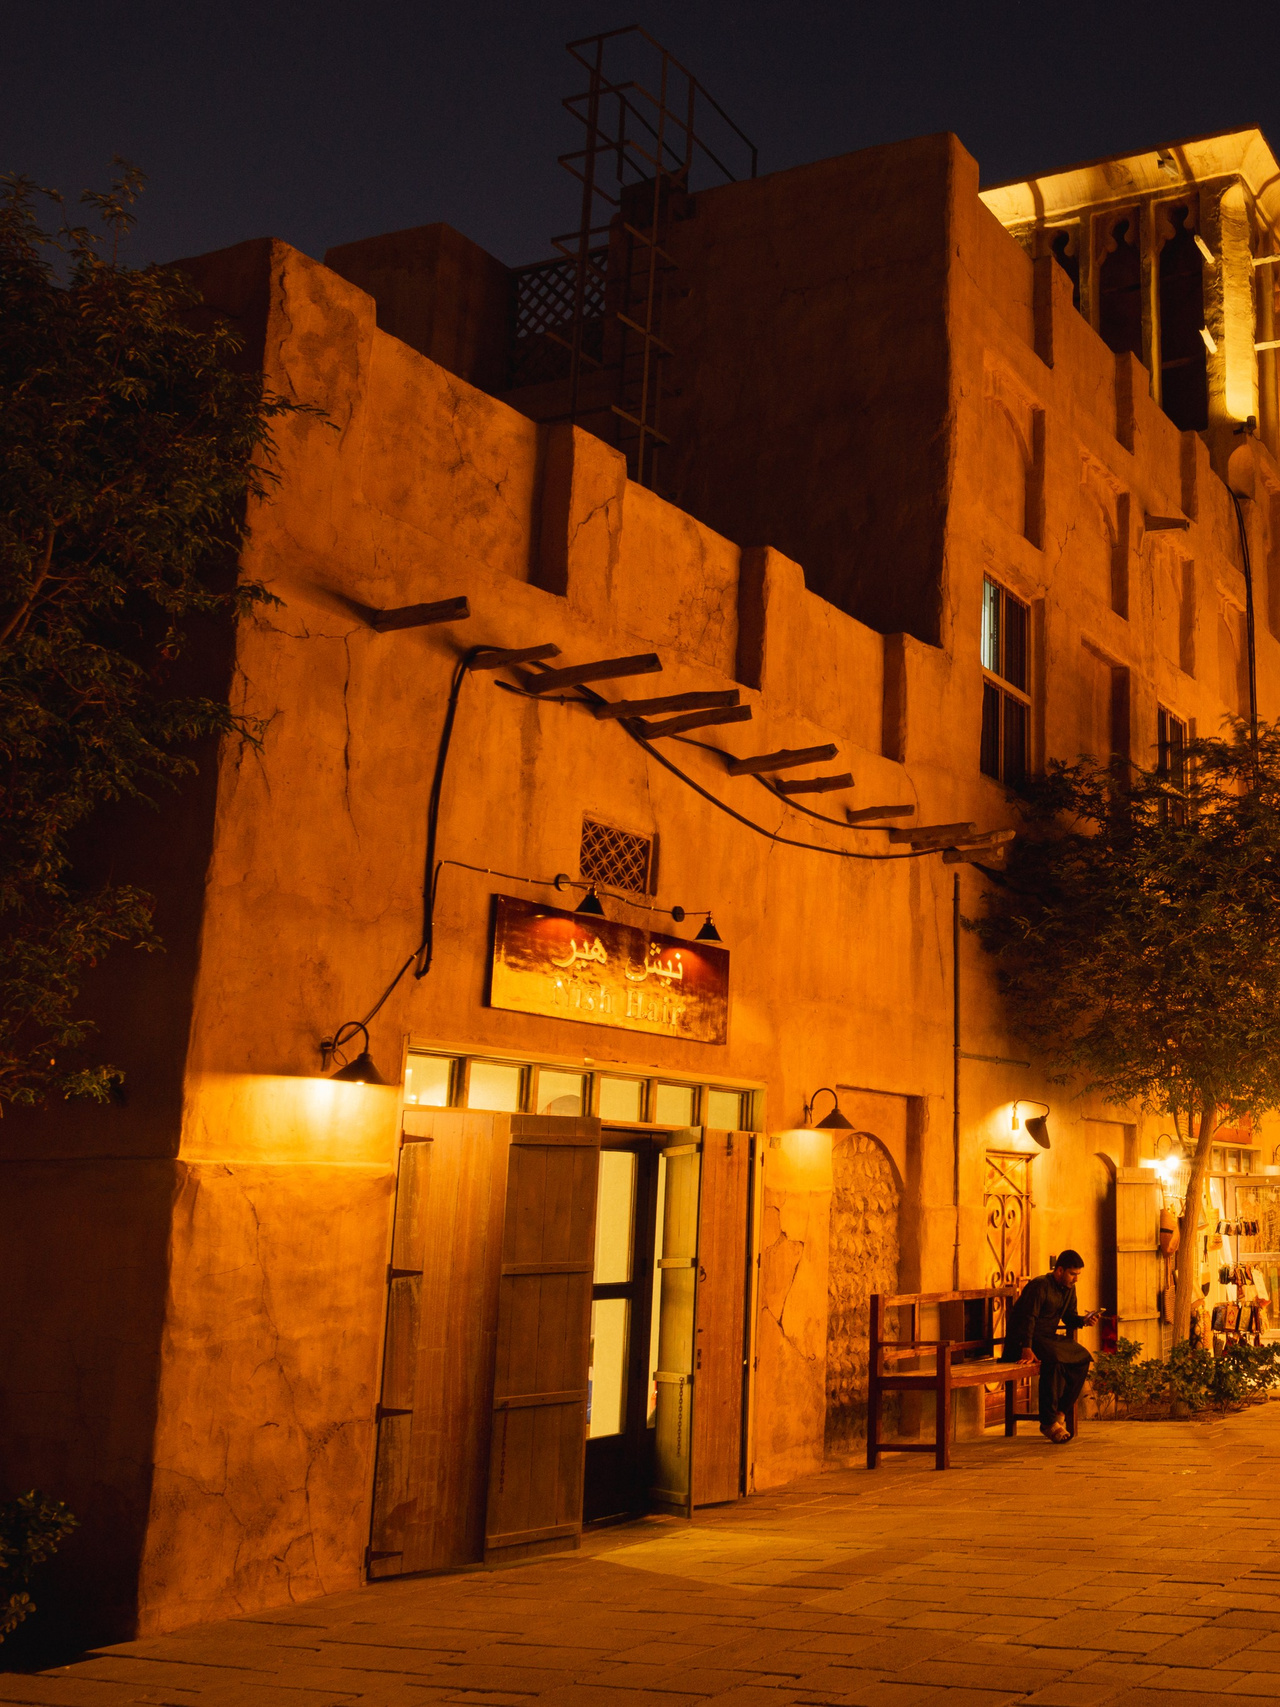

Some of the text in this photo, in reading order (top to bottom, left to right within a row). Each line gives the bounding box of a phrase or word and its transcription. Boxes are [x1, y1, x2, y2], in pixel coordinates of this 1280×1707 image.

[552, 937, 683, 986] نيش هير
[552, 977, 685, 1026] Nish Hair
